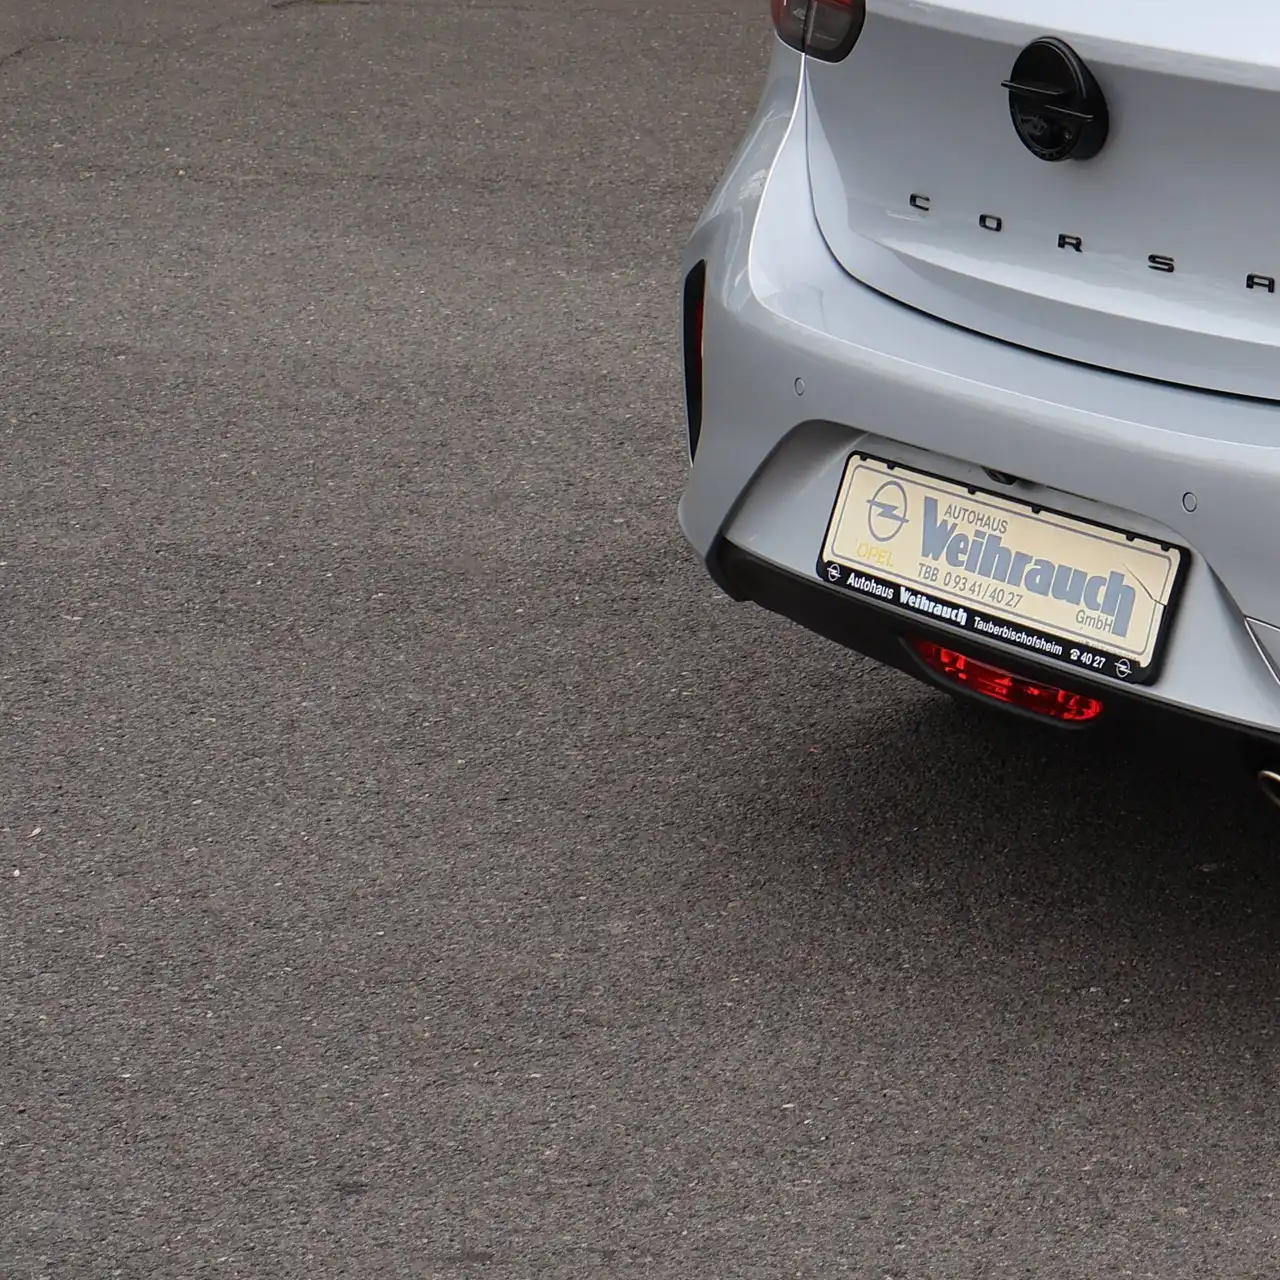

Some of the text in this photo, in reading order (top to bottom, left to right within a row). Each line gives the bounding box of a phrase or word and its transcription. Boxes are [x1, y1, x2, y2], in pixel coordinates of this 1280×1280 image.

[909, 193, 1276, 293] CORSA
[944, 504, 1009, 534] AUTOHAUS
[856, 541, 894, 568] OPEL
[921, 495, 1136, 638] Weihrauch
[917, 562, 940, 582] TBB
[846, 572, 895, 600] Autohaus
[899, 586, 968, 626] Weihrauch
[973, 616, 1063, 656] Tauberbischofsheim
[1080, 654, 1093, 666] 40
[1094, 657, 1106, 670] 27
[1075, 609, 1113, 634] GmbH
